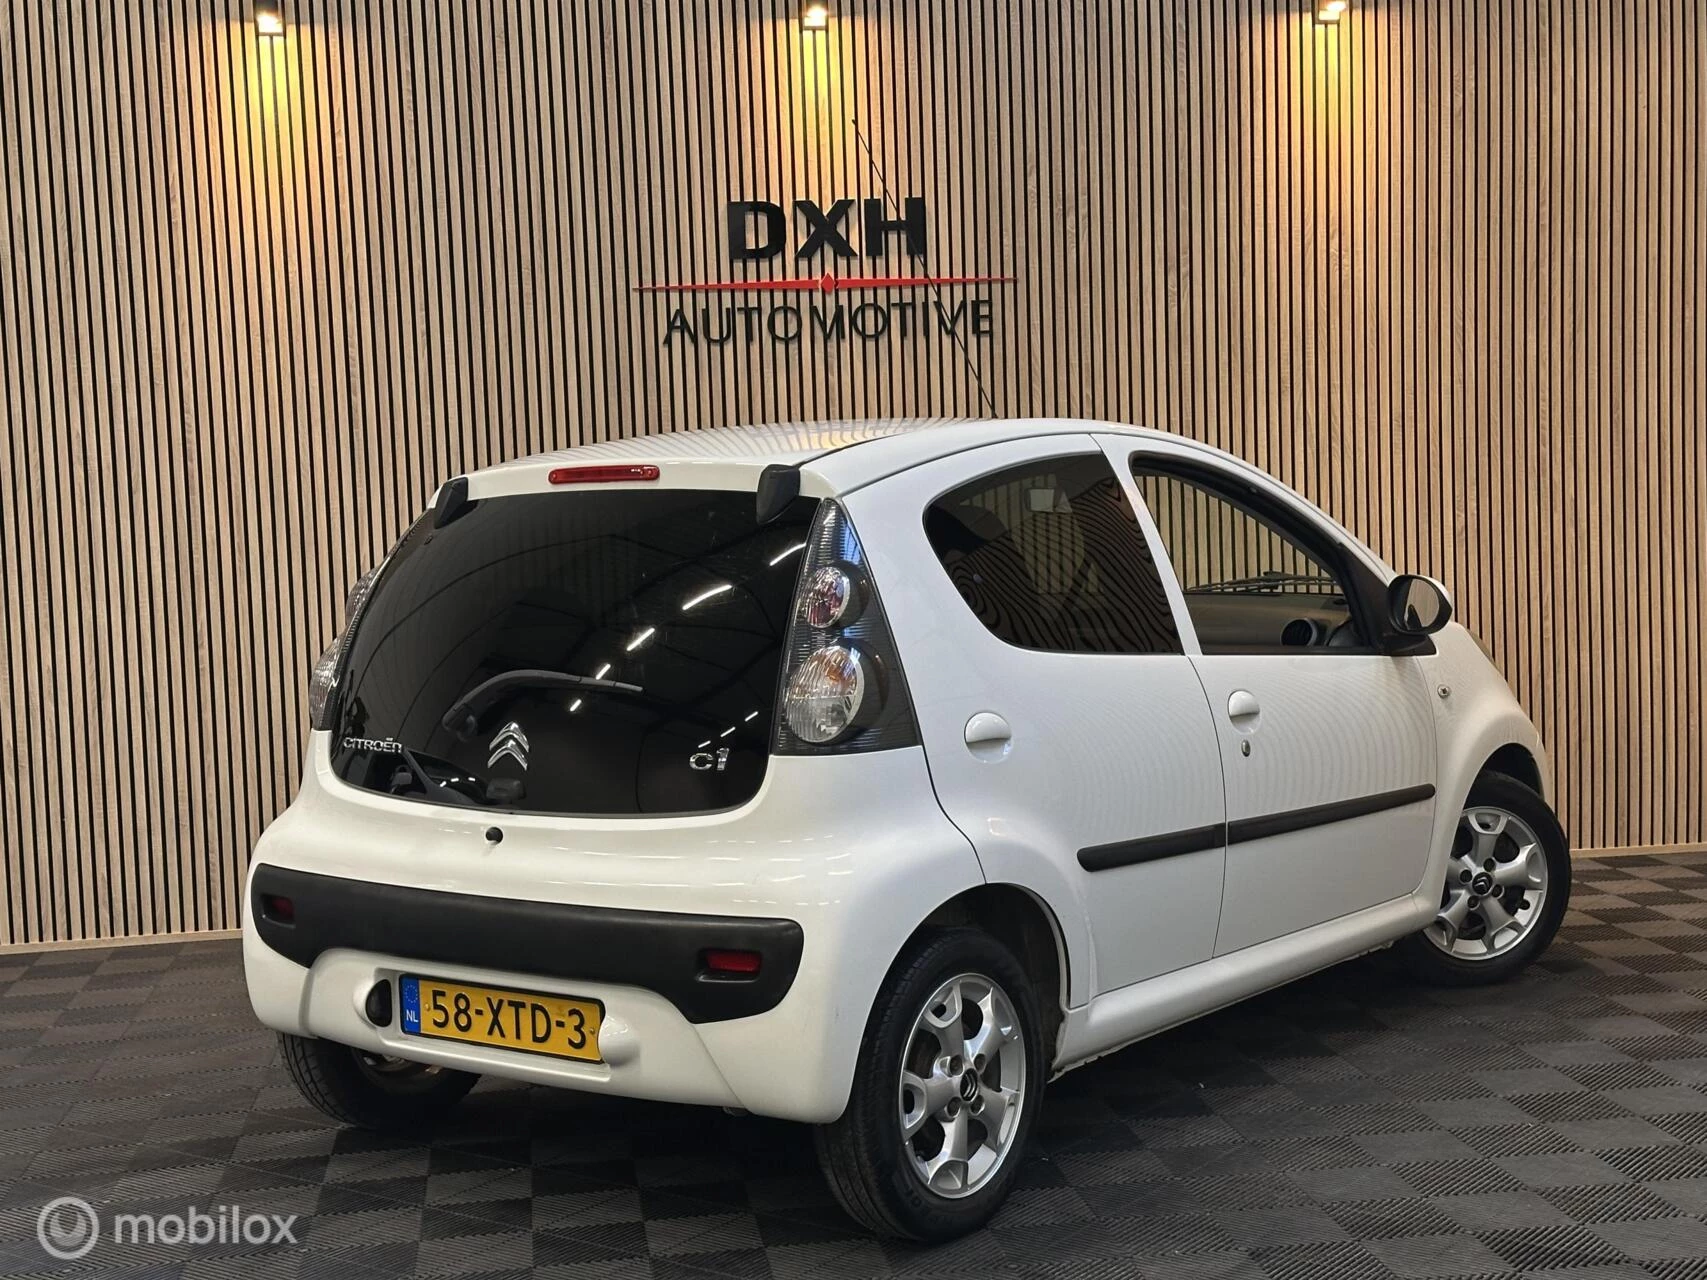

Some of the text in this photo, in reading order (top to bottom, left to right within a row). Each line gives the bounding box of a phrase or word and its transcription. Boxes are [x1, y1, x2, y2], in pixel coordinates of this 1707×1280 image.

[727, 197, 925, 260] DXH
[662, 299, 993, 345] AUTOMOTIVE
[406, 1009, 419, 1023] NL
[432, 989, 586, 1049] 58-XTD-3
